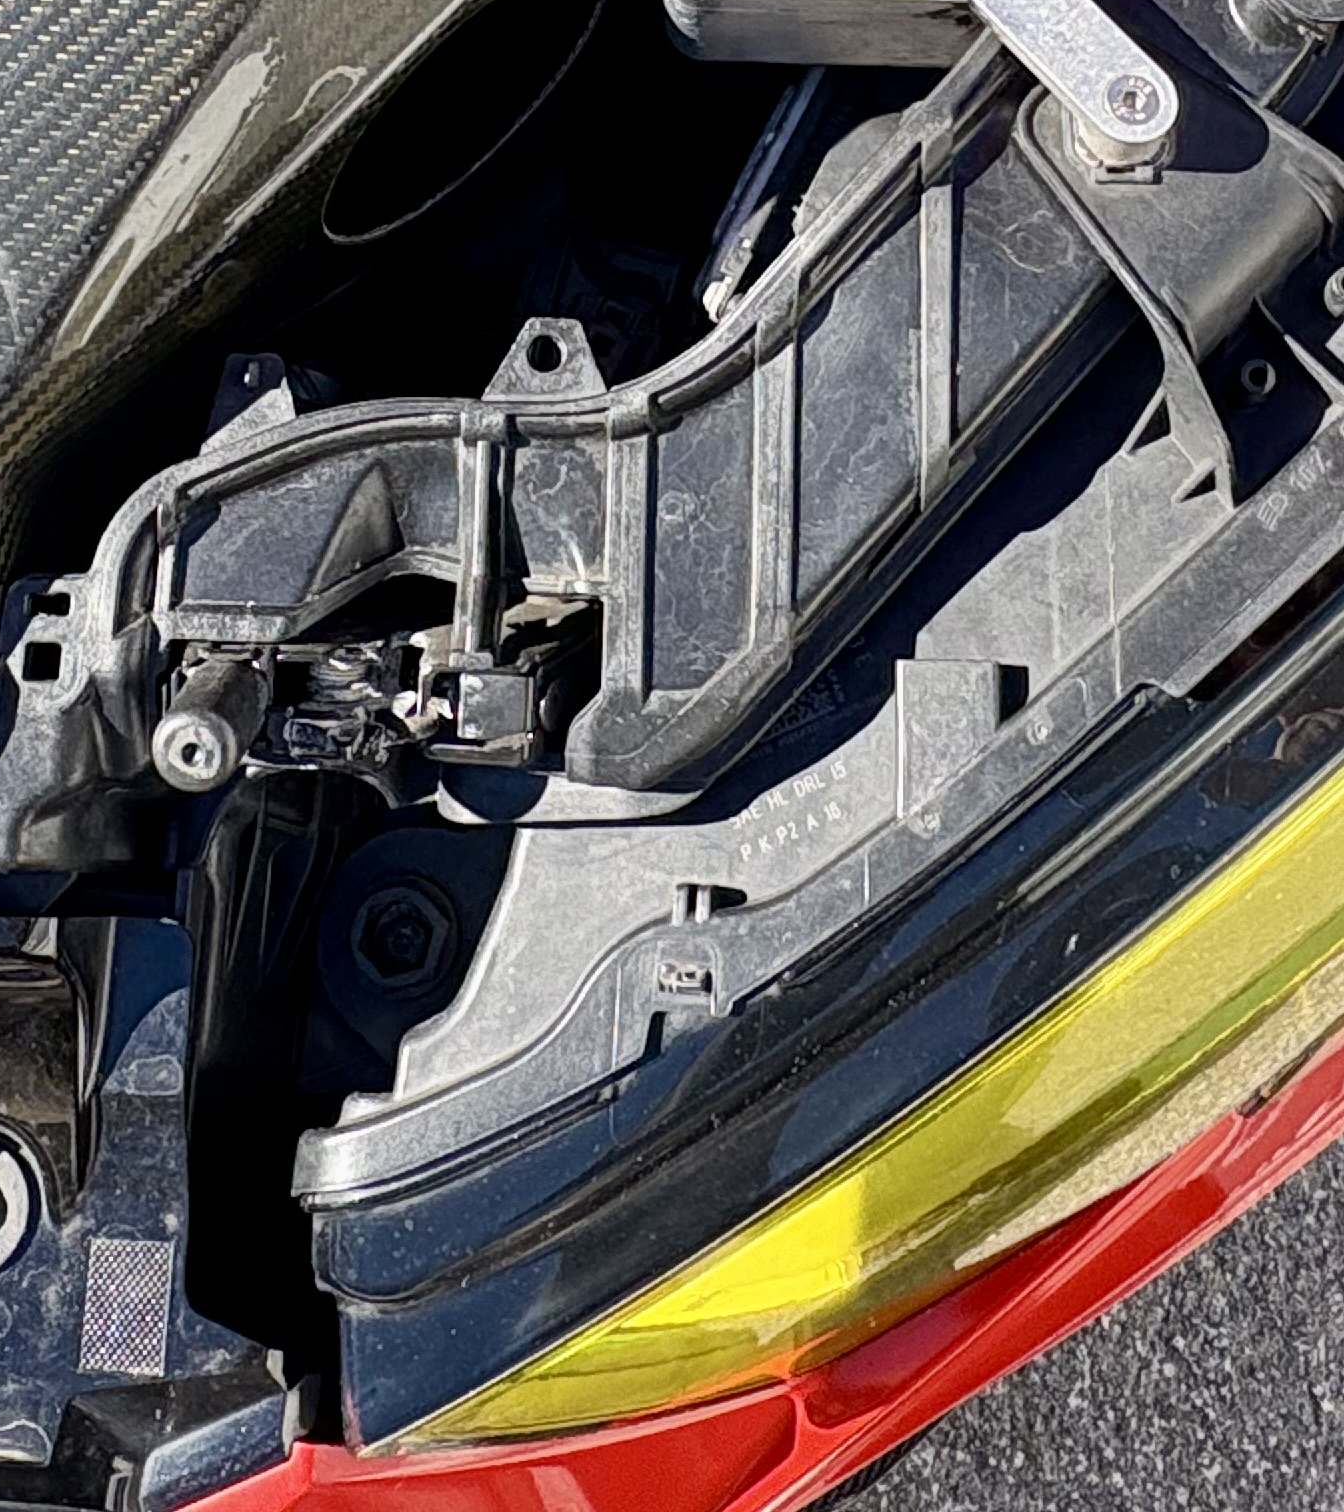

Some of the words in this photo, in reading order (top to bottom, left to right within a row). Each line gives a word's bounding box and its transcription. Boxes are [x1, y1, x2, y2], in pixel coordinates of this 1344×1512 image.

[766, 789, 789, 813] HL
[792, 772, 826, 798] DRL
[740, 842, 752, 862] P
[758, 834, 772, 854] K
[806, 813, 820, 832] A
